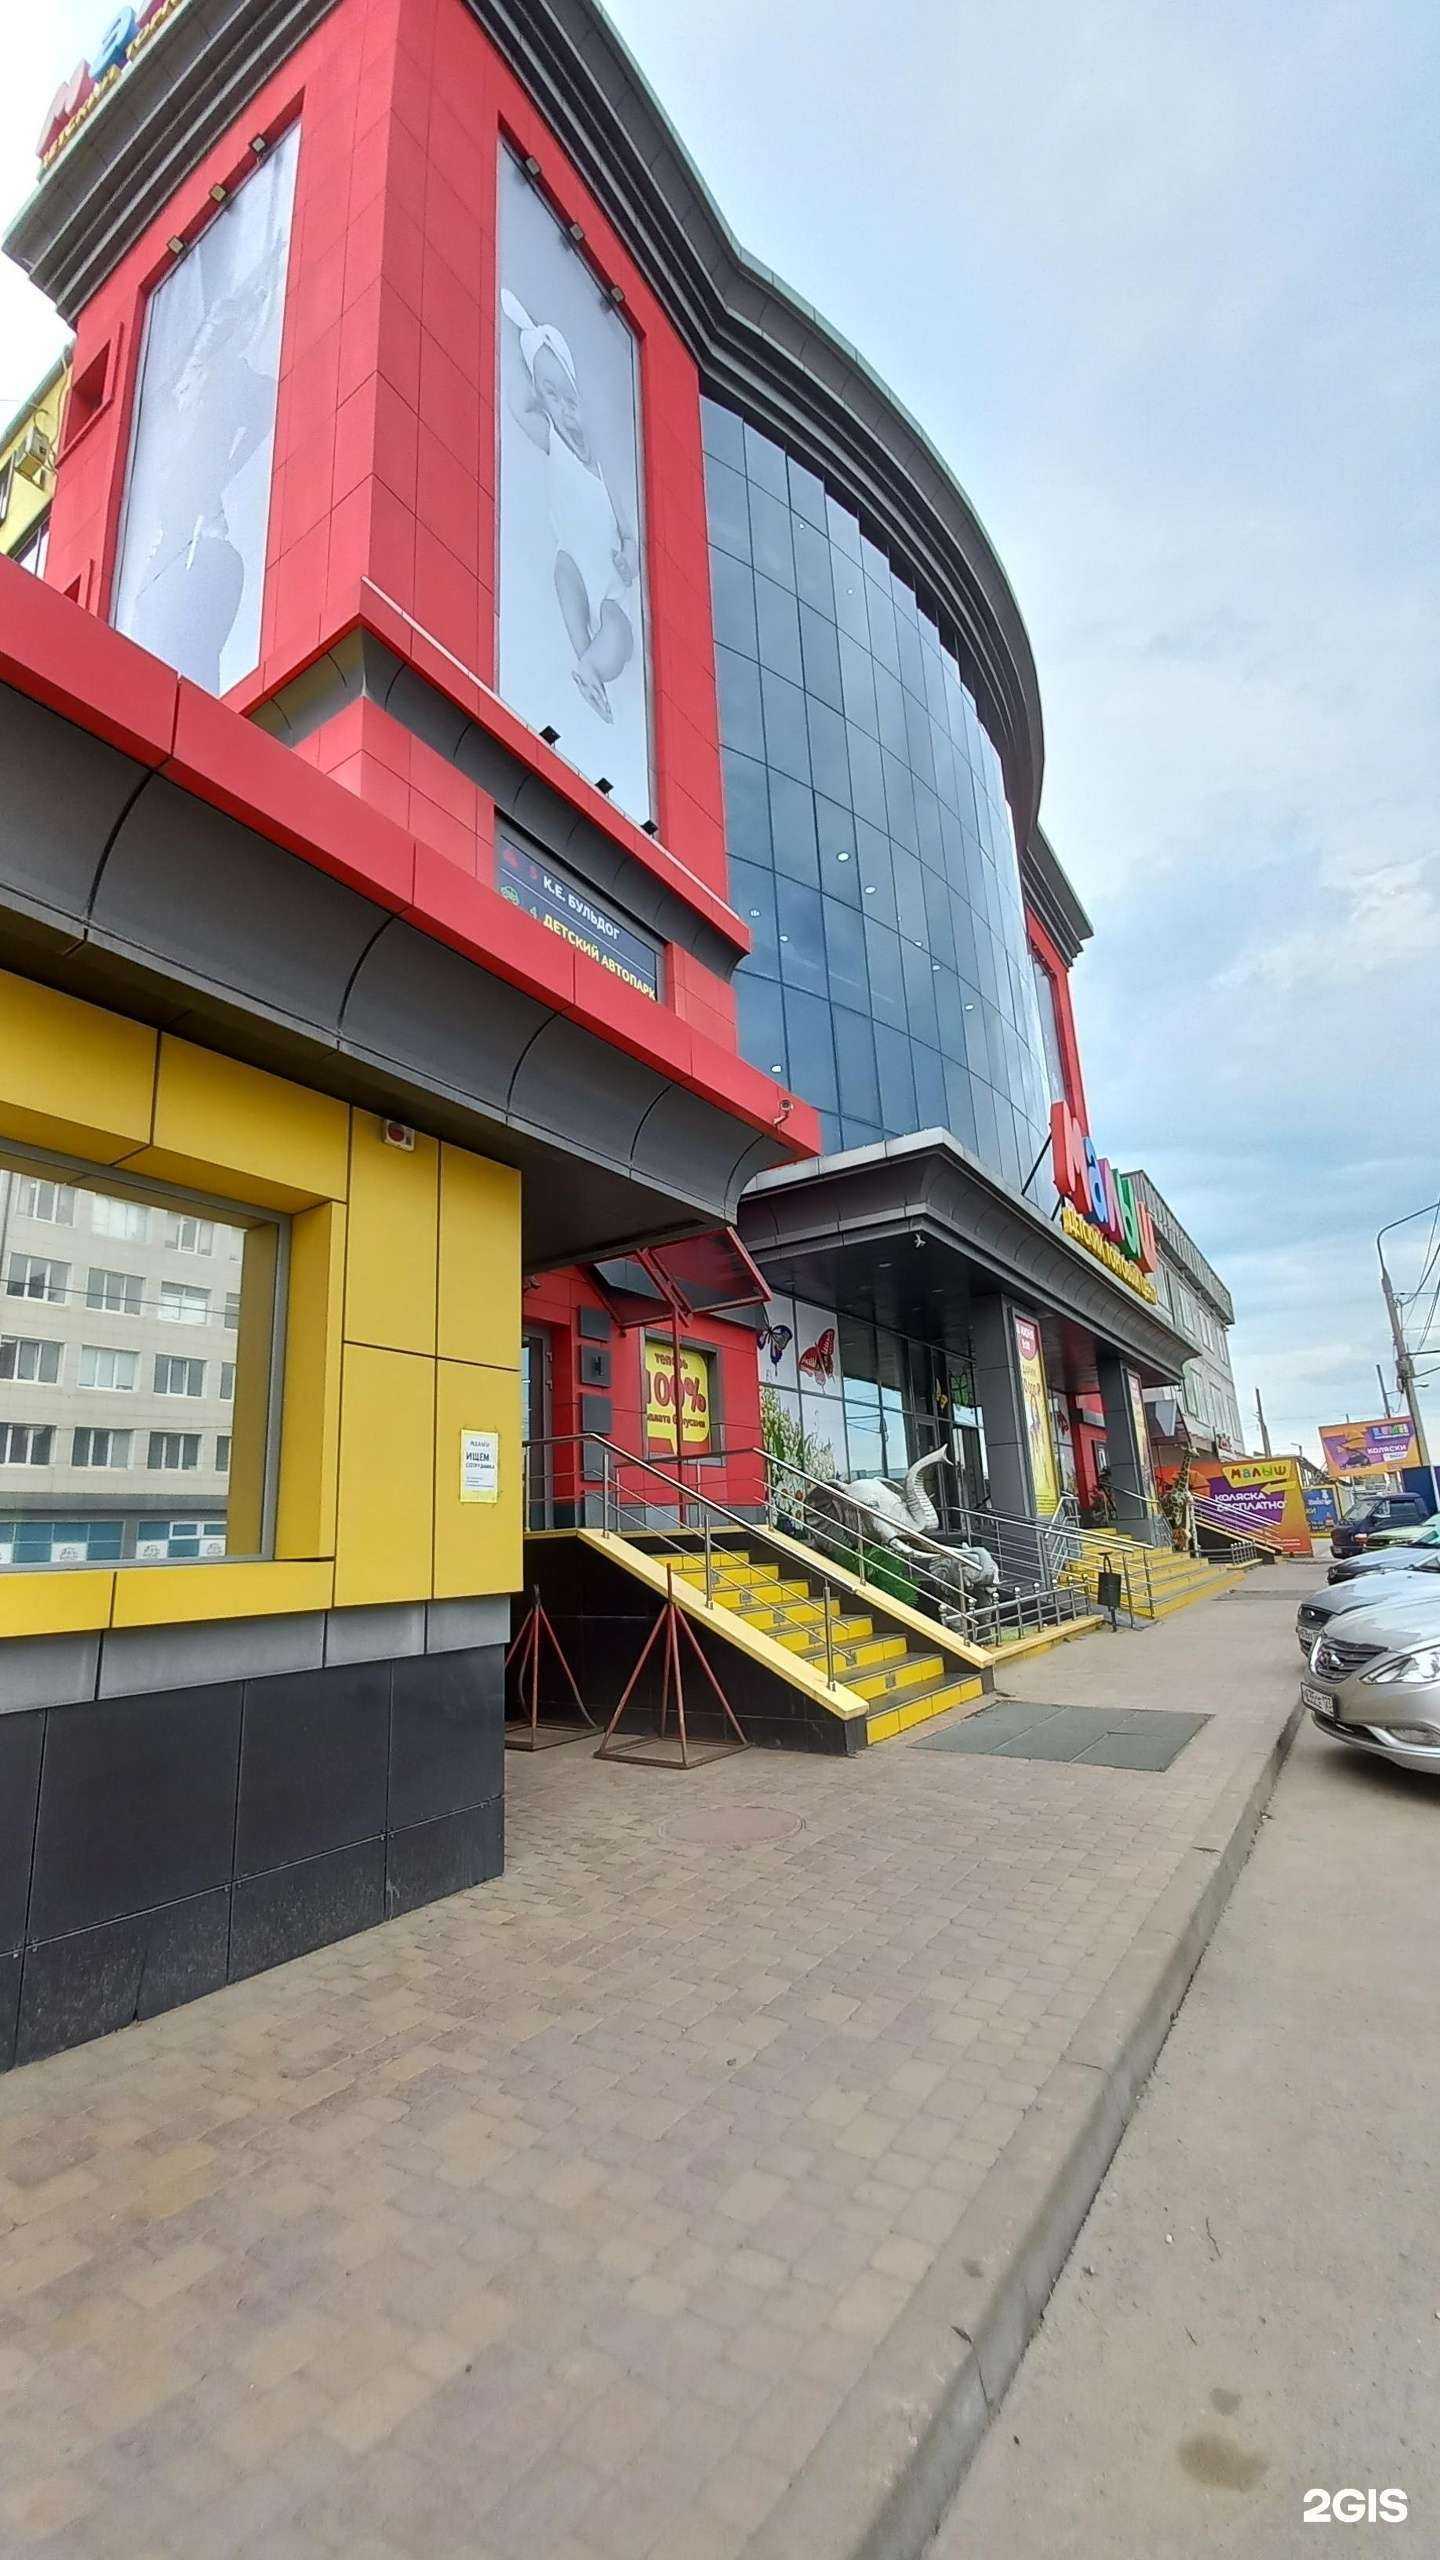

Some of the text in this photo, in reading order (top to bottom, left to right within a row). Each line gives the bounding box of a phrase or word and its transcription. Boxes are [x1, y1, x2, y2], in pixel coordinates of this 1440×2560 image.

[543, 875, 566, 902] К.Е.
[568, 895, 621, 940] БУЛЬДОГ
[543, 914, 600, 962] ДЕТСКИЙ
[601, 955, 657, 1001] АВТОПАРК
[1367, 1444, 1407, 1455] КОЛЯСКИ
[466, 1452, 490, 1461] ИЩЕМ
[1215, 1492, 1266, 1502] КОЛЯСКА
[1216, 1500, 1286, 1512] БСПЛАТНО
